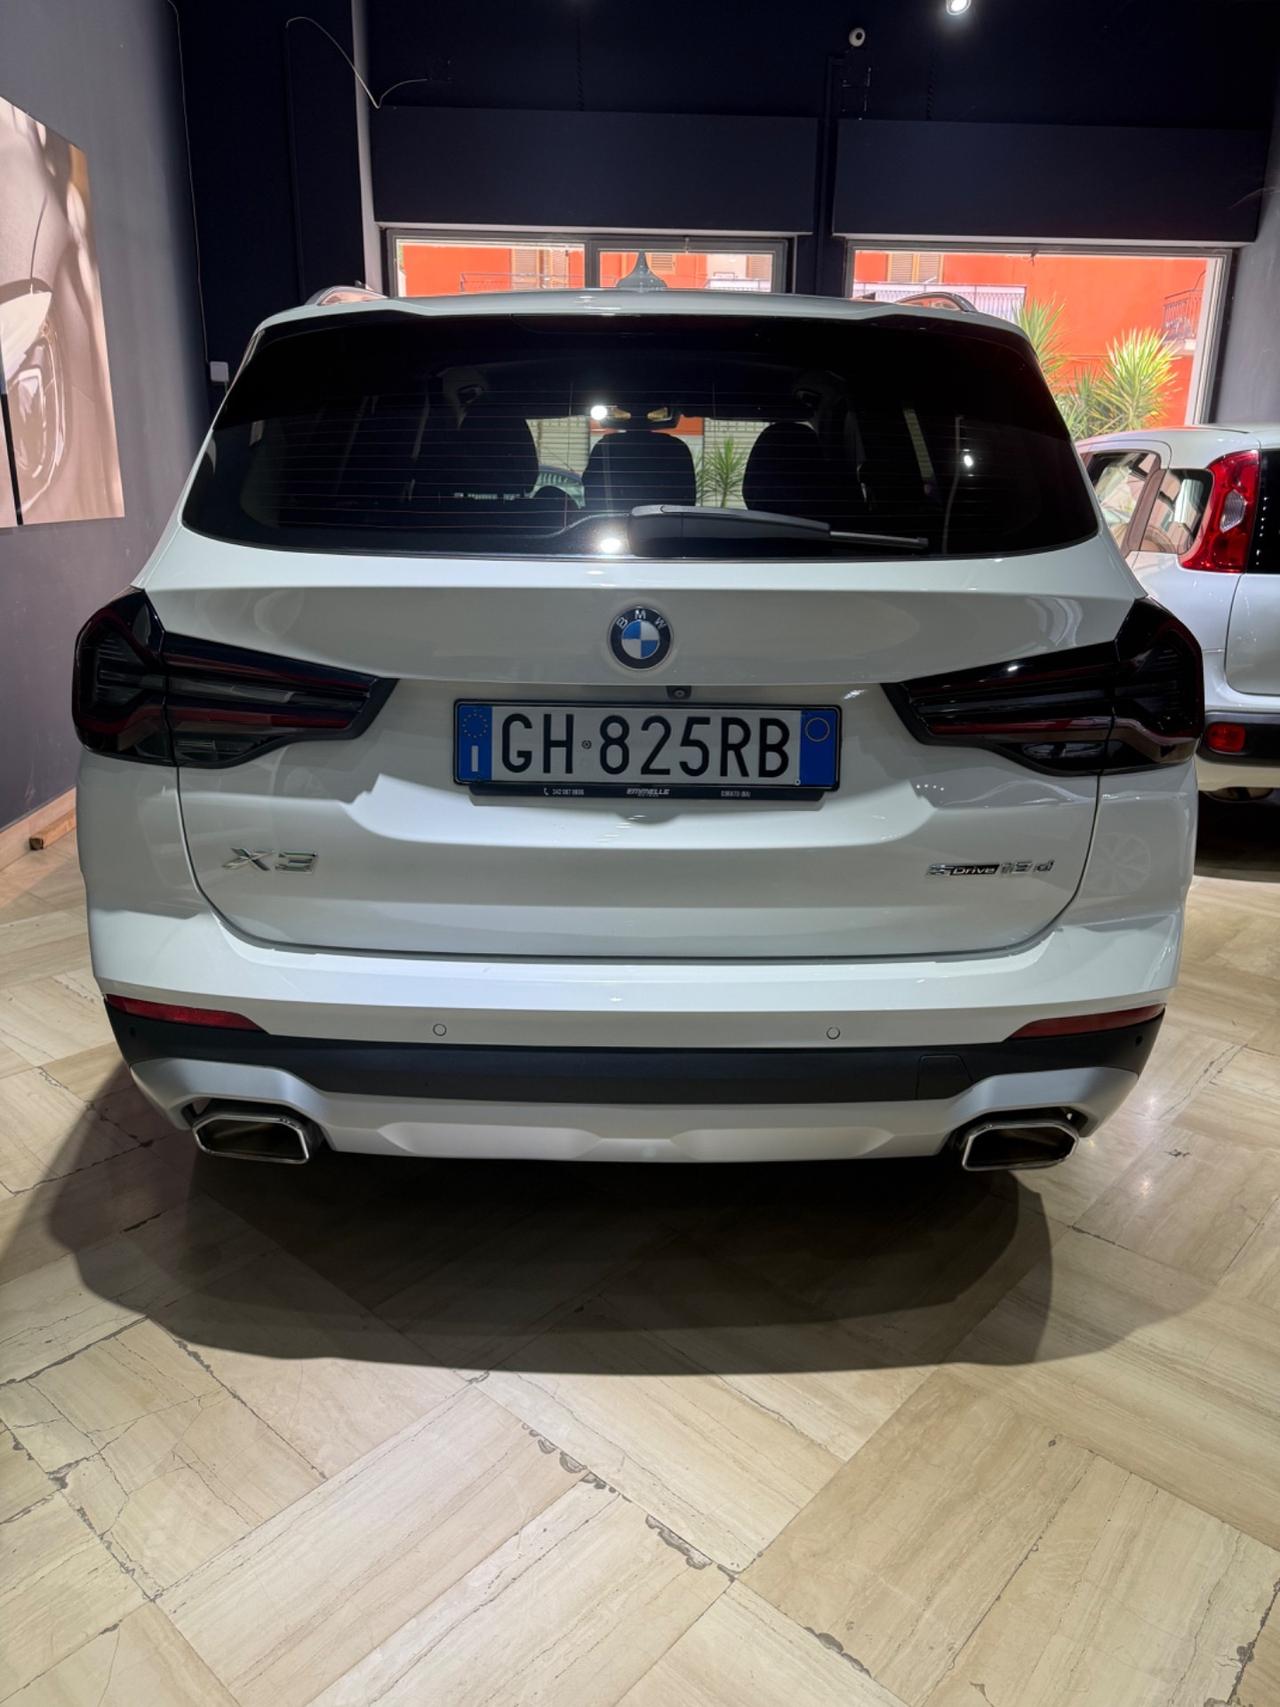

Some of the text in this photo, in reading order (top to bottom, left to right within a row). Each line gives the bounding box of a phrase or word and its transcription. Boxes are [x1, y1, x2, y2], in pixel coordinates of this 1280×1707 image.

[616, 609, 667, 629] BMW
[502, 713, 575, 774] GH
[221, 847, 319, 873] X3
